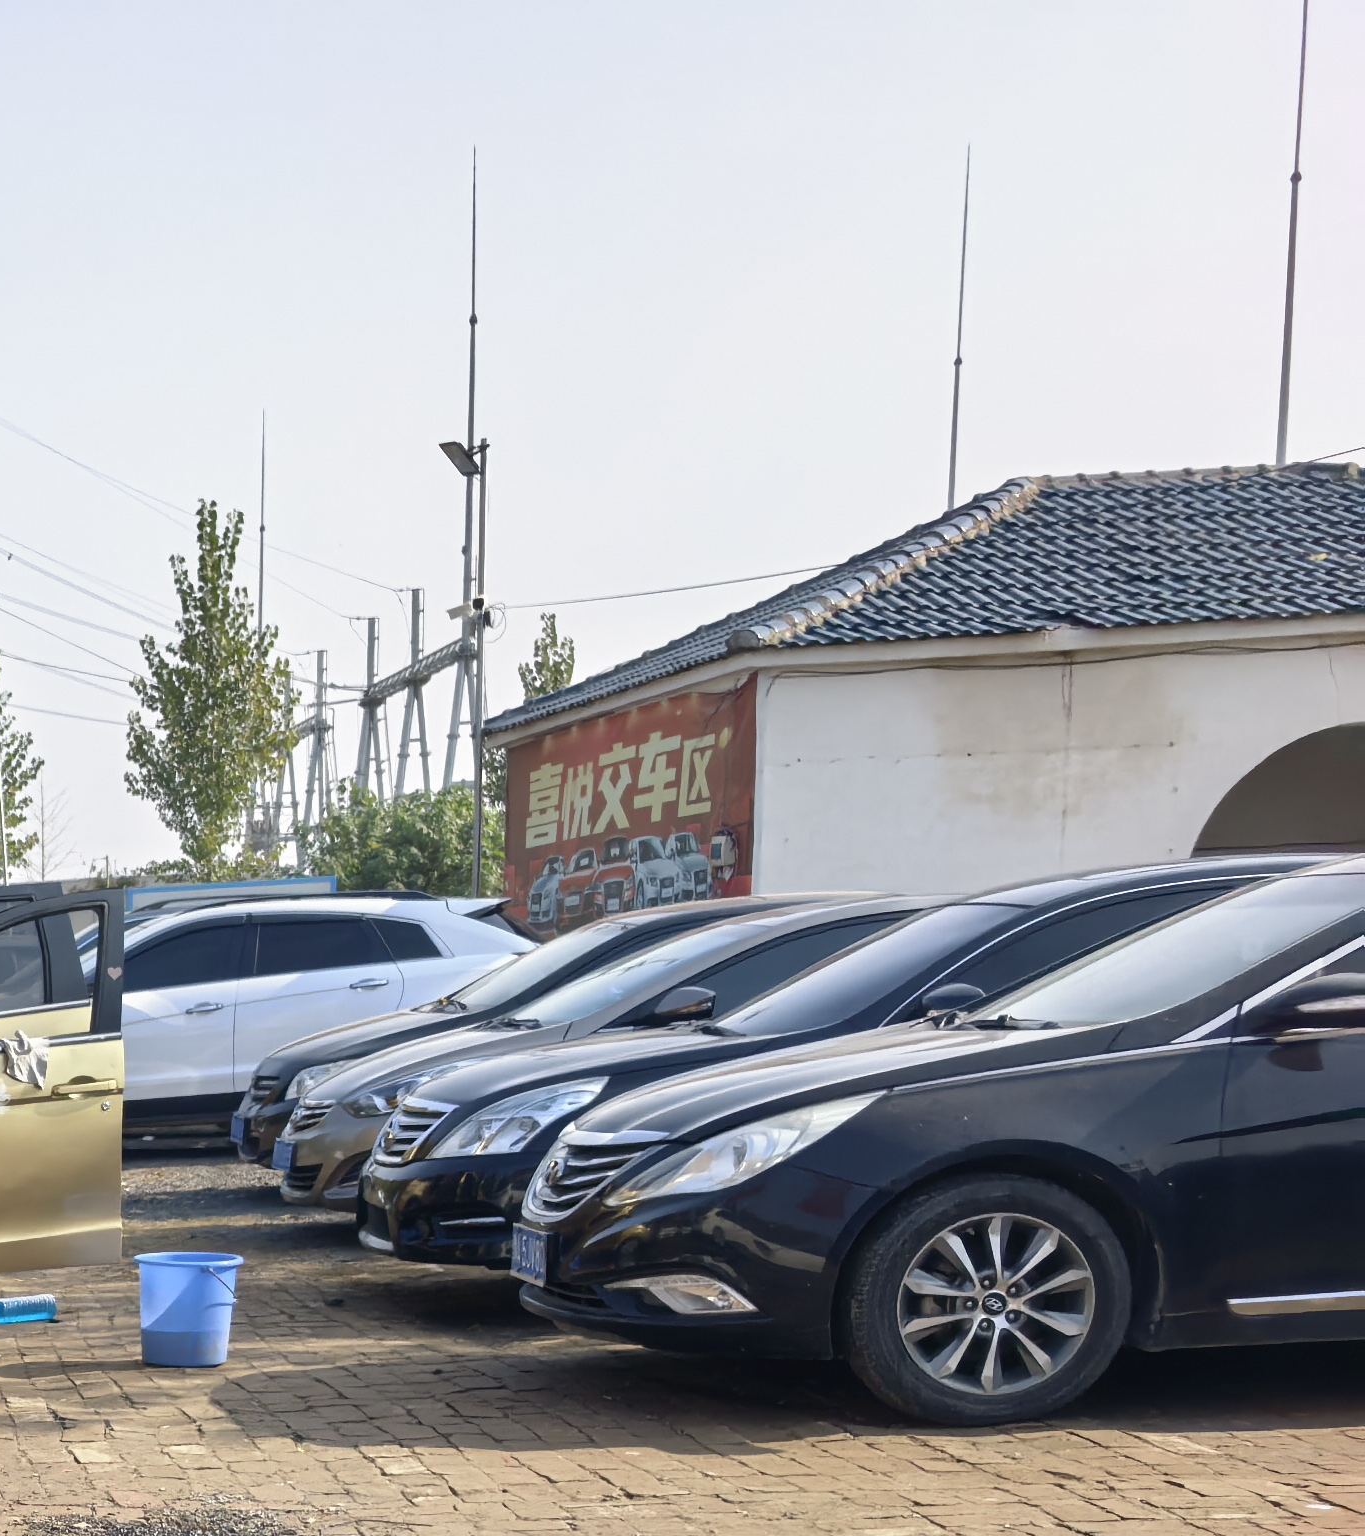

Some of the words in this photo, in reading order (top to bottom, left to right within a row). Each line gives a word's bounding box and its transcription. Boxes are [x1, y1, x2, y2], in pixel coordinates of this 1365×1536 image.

[525, 731, 716, 849] 喜悦交车区
